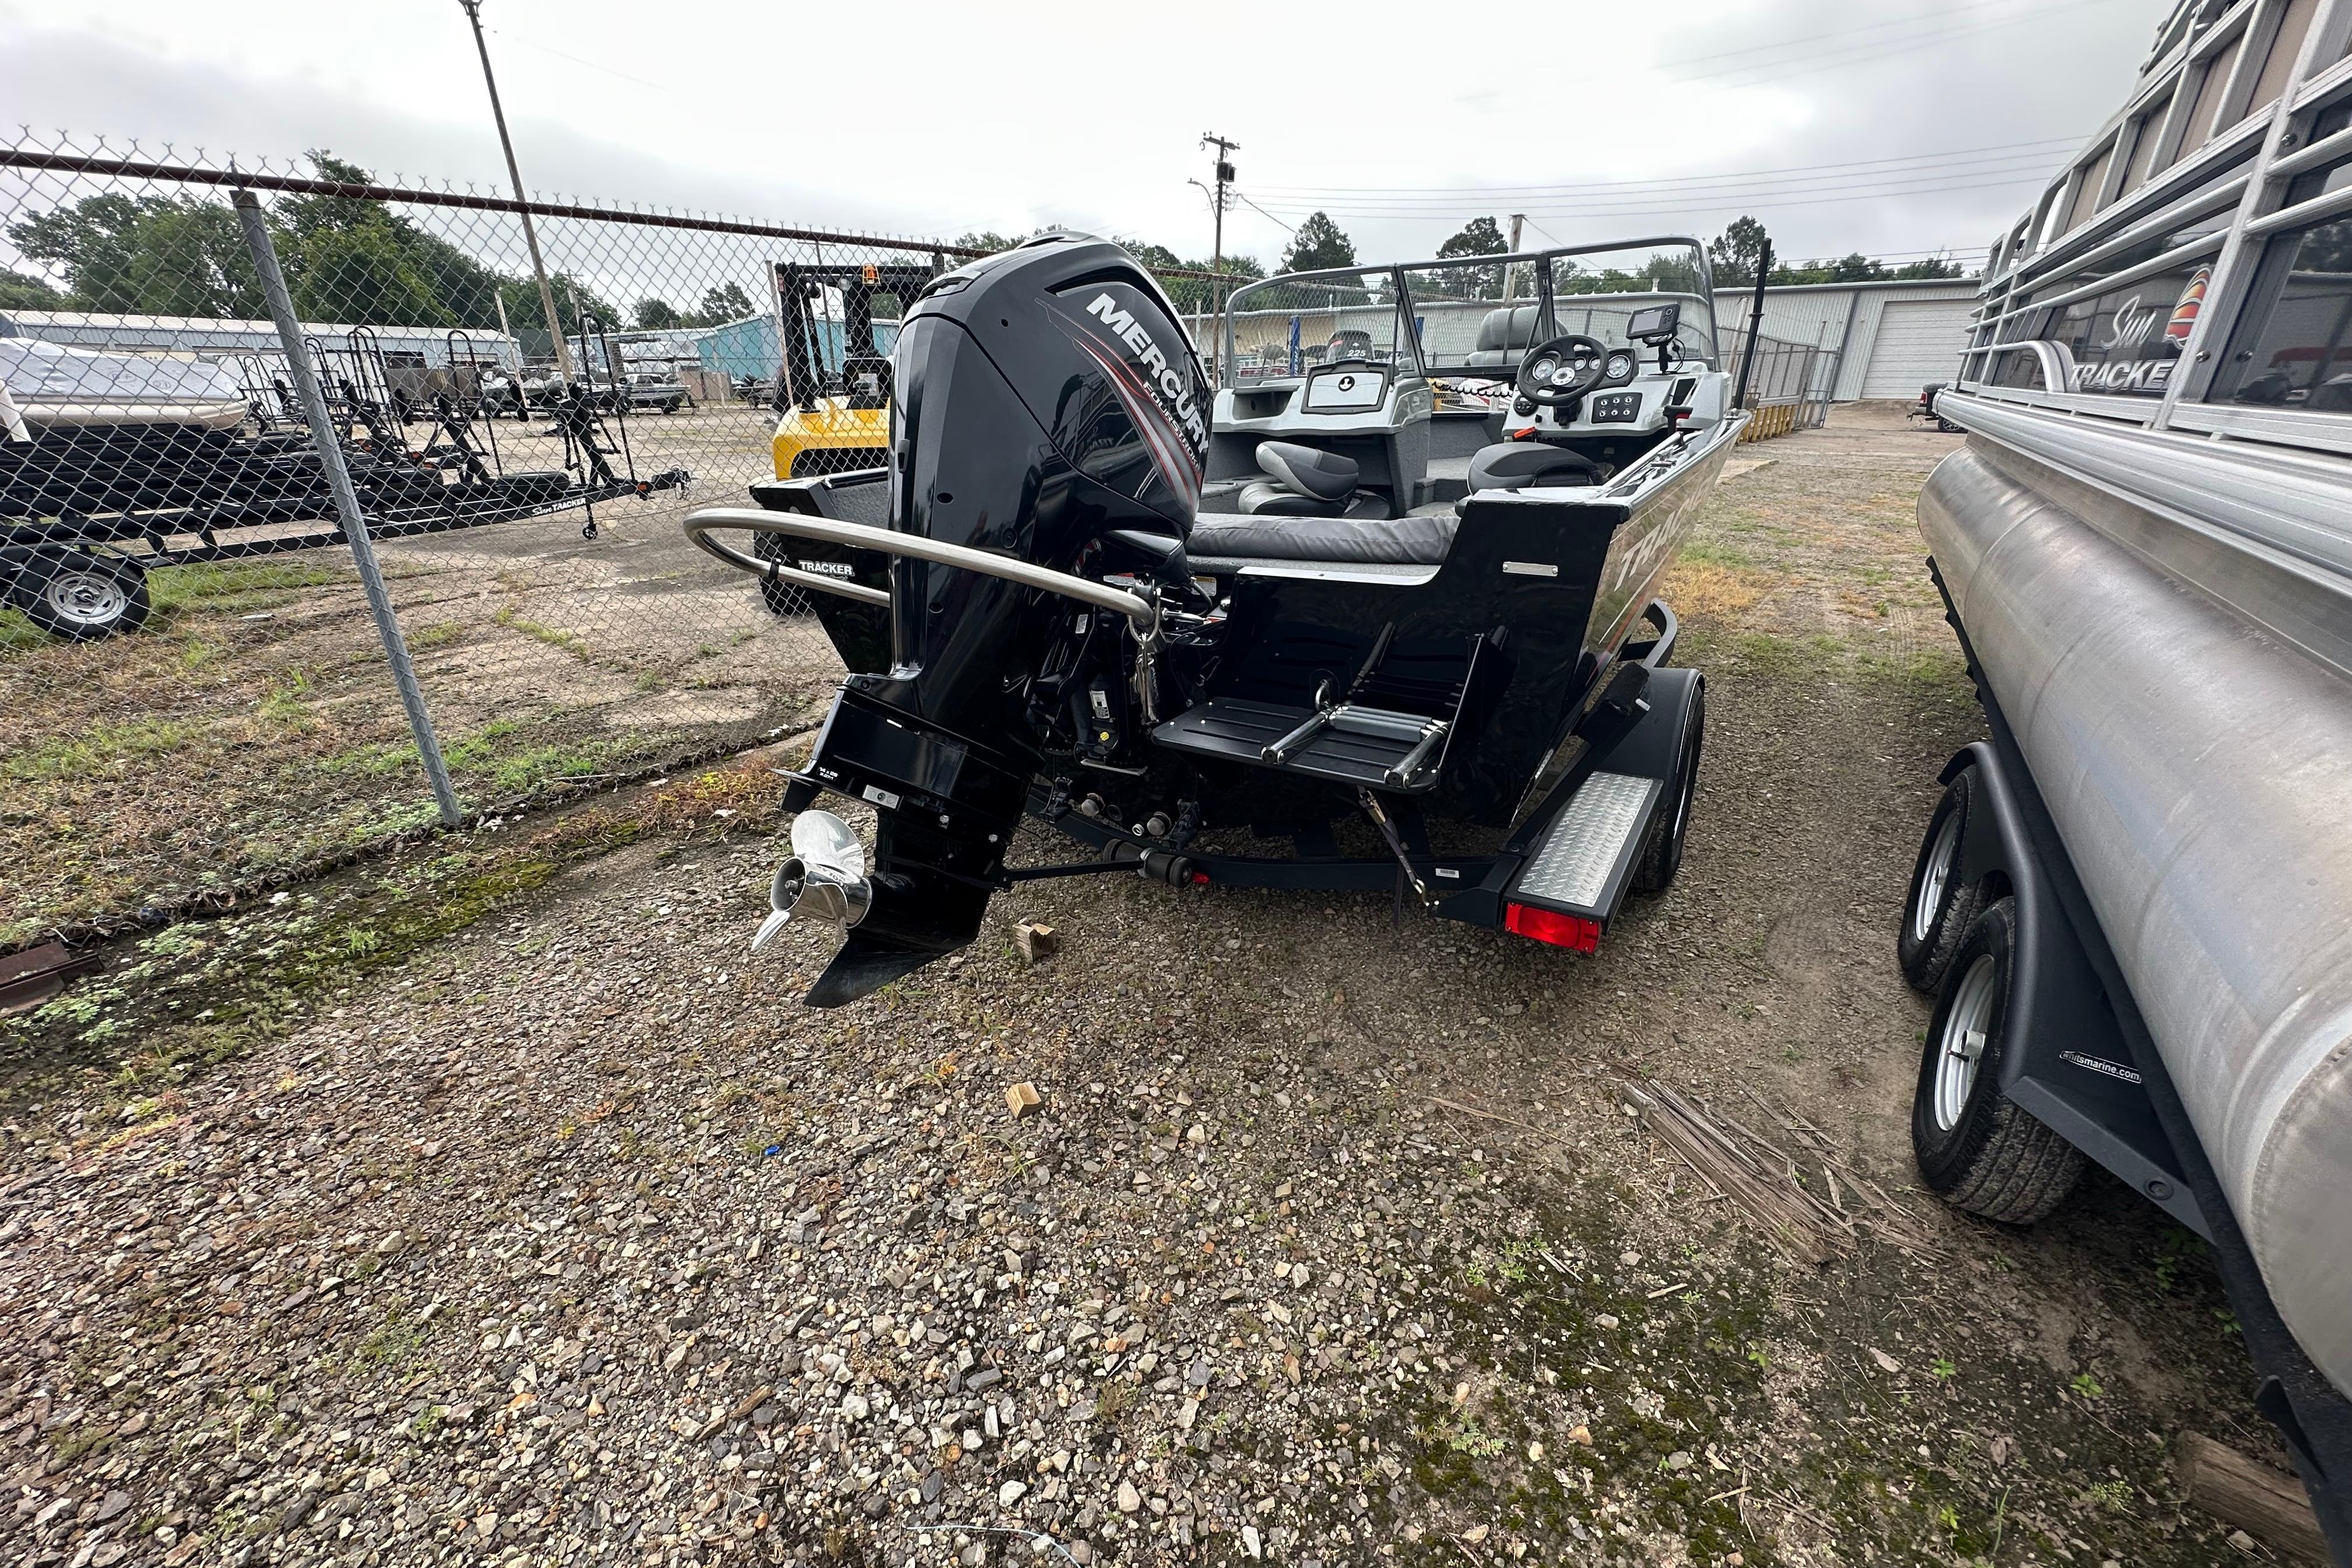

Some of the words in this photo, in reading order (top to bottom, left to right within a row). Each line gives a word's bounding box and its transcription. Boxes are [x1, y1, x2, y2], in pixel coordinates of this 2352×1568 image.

[2100, 294, 2157, 350] Sun
[1086, 292, 1209, 454] MERCURY
[2069, 358, 2178, 390] TRACKE
[552, 497, 587, 512] TRACKER
[799, 561, 853, 575] TRACKER
[2063, 1052, 2140, 1081] whitsmarine.com
